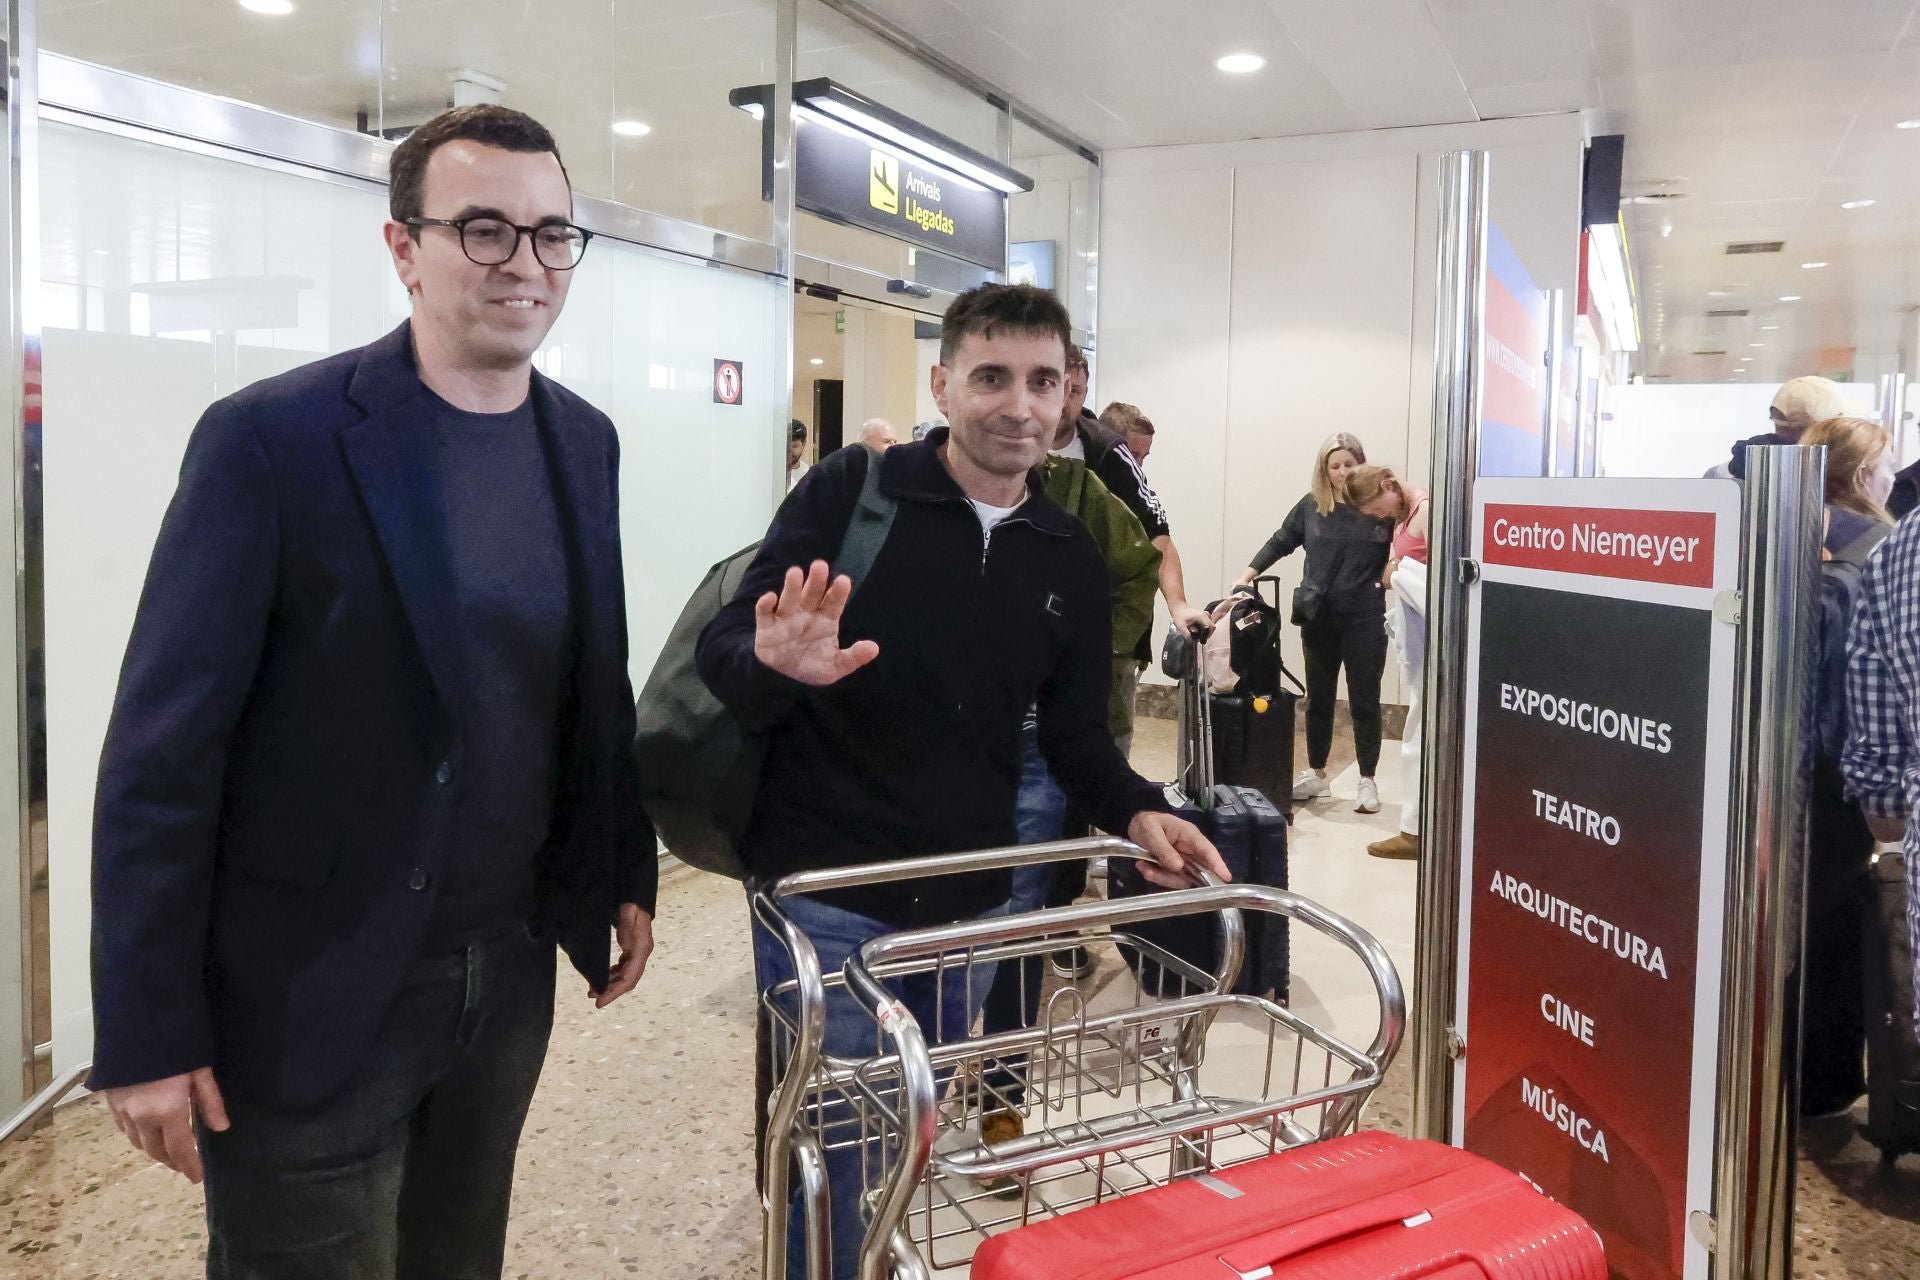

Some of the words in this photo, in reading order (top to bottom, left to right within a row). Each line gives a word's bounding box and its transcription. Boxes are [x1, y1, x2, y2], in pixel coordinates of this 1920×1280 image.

[905, 170, 941, 202] Arrivals
[905, 196, 954, 235] Llegadas
[1493, 518, 1565, 551] Centro
[1571, 523, 1700, 566] Niemeyer
[1500, 683, 1672, 754] EXPOSICIONES
[1532, 789, 1621, 846] TEATRO
[1490, 870, 1668, 980] ARQUITECTURA
[1540, 993, 1595, 1047] CINE
[1522, 1077, 1610, 1164] MÚSICA
